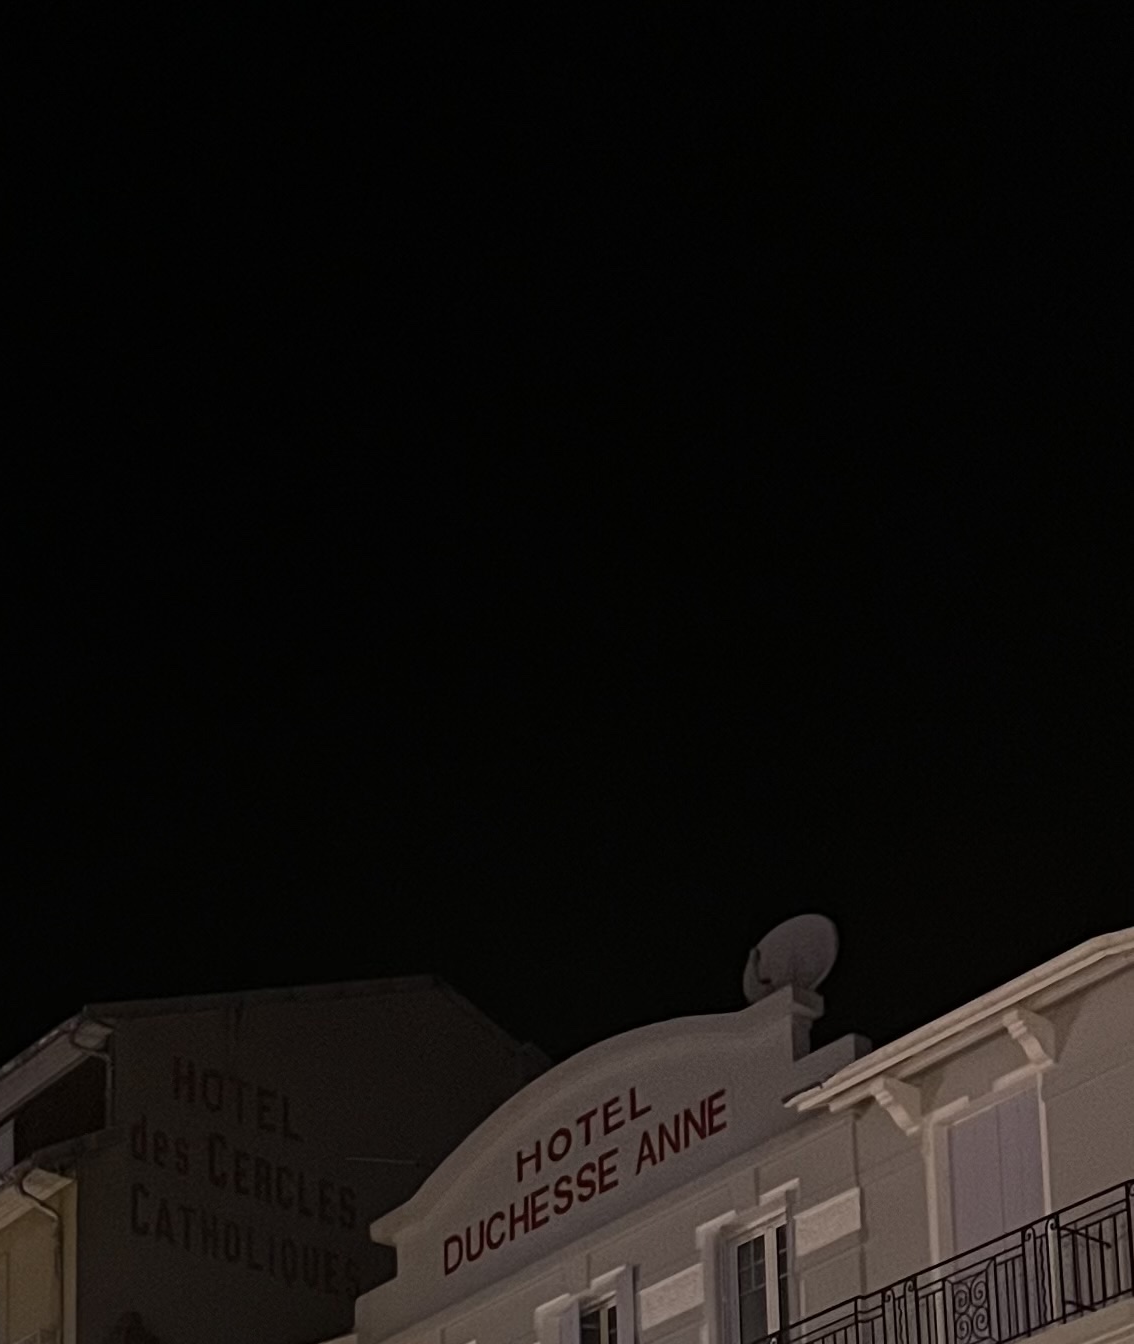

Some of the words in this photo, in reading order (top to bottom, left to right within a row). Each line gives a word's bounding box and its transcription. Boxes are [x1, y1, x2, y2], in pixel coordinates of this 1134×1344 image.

[172, 1055, 304, 1143] HOTEL
[516, 1086, 653, 1183] HOTEL
[131, 1114, 190, 1178] des
[443, 1147, 620, 1276] DUCHESSE
[634, 1088, 728, 1176] ANNE
